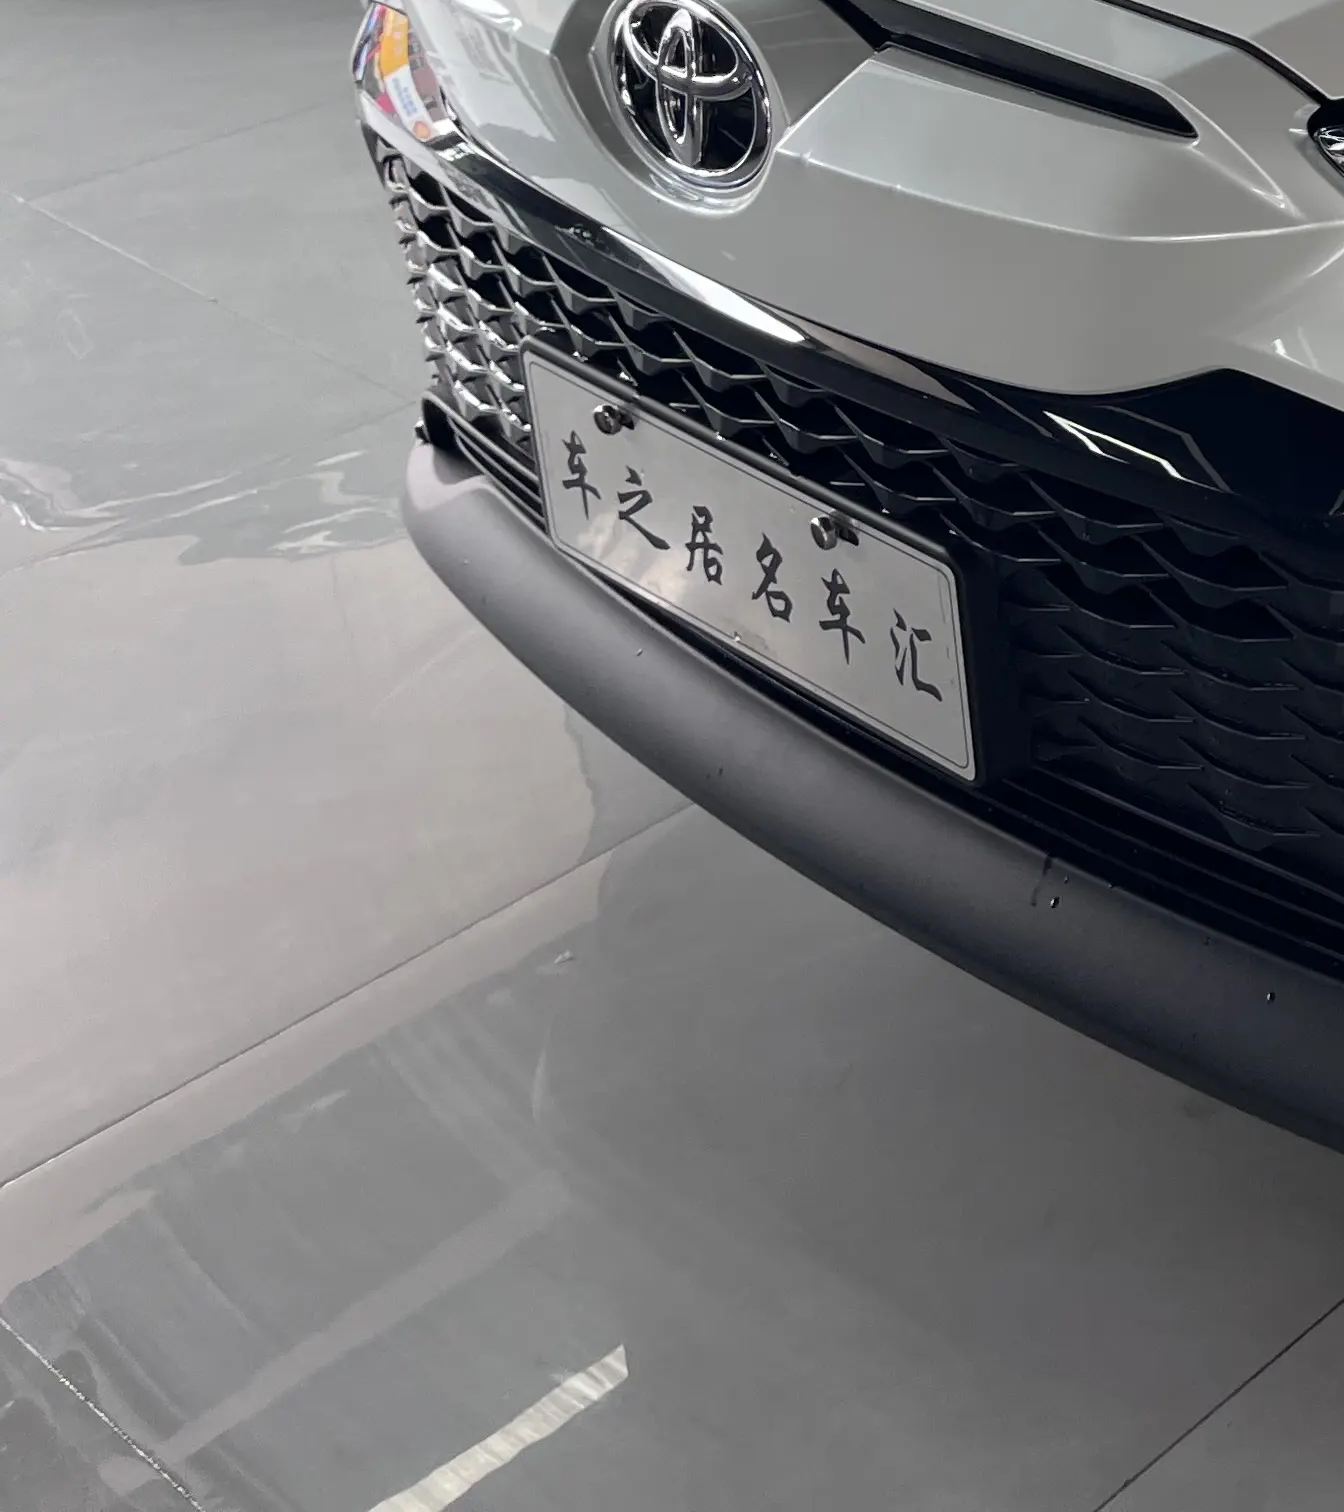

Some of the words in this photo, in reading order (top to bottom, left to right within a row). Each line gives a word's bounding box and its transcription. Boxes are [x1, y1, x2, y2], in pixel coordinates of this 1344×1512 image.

[561, 430, 943, 702] 车之居名车汇
